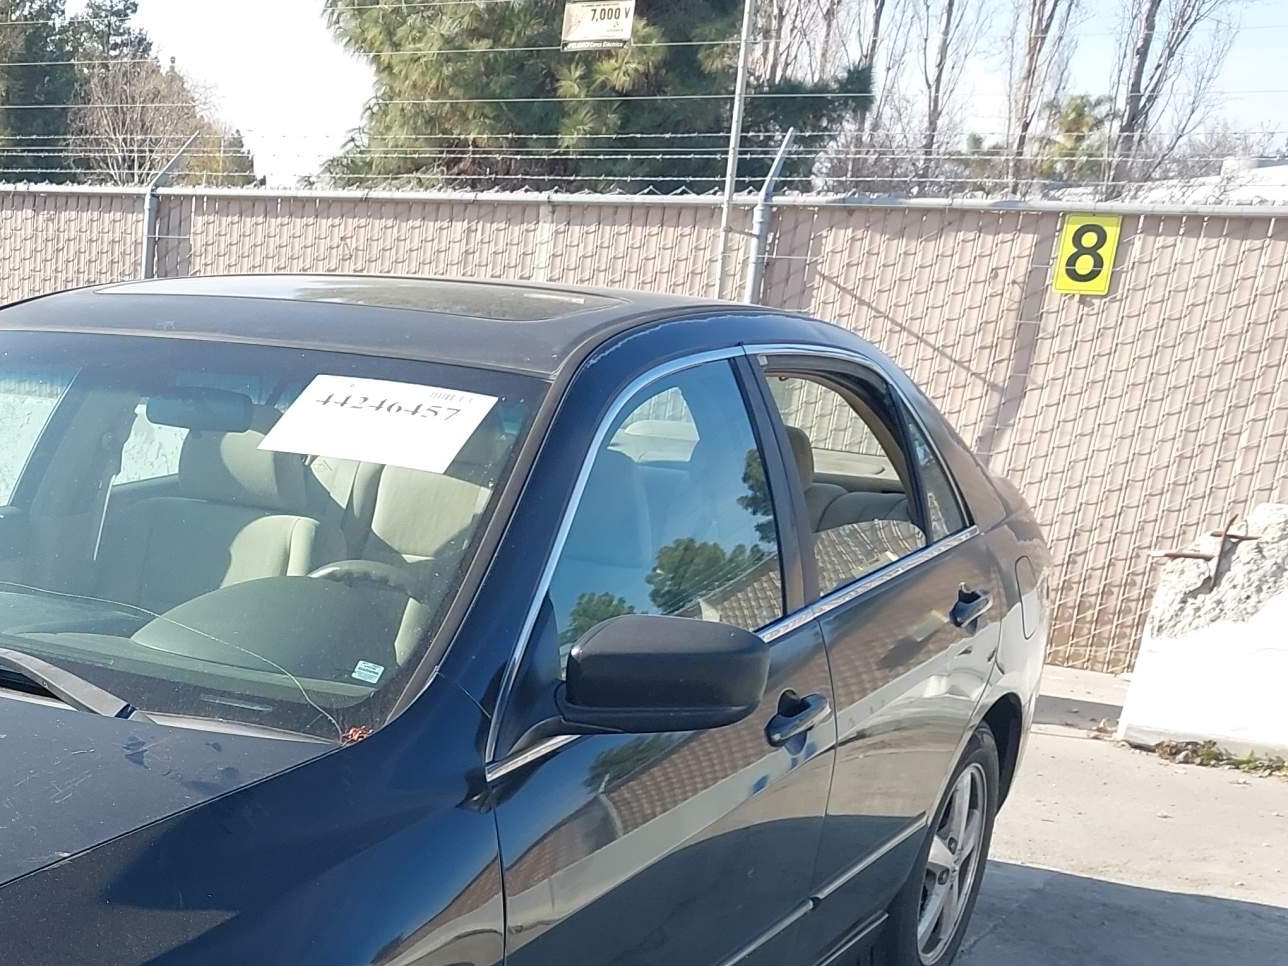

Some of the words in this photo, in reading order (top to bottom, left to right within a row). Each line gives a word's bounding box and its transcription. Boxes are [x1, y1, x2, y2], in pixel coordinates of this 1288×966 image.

[590, 7, 621, 22] 7,000
[624, 7, 631, 19] V
[1065, 223, 1108, 283] 8
[316, 392, 463, 422] 44246457
